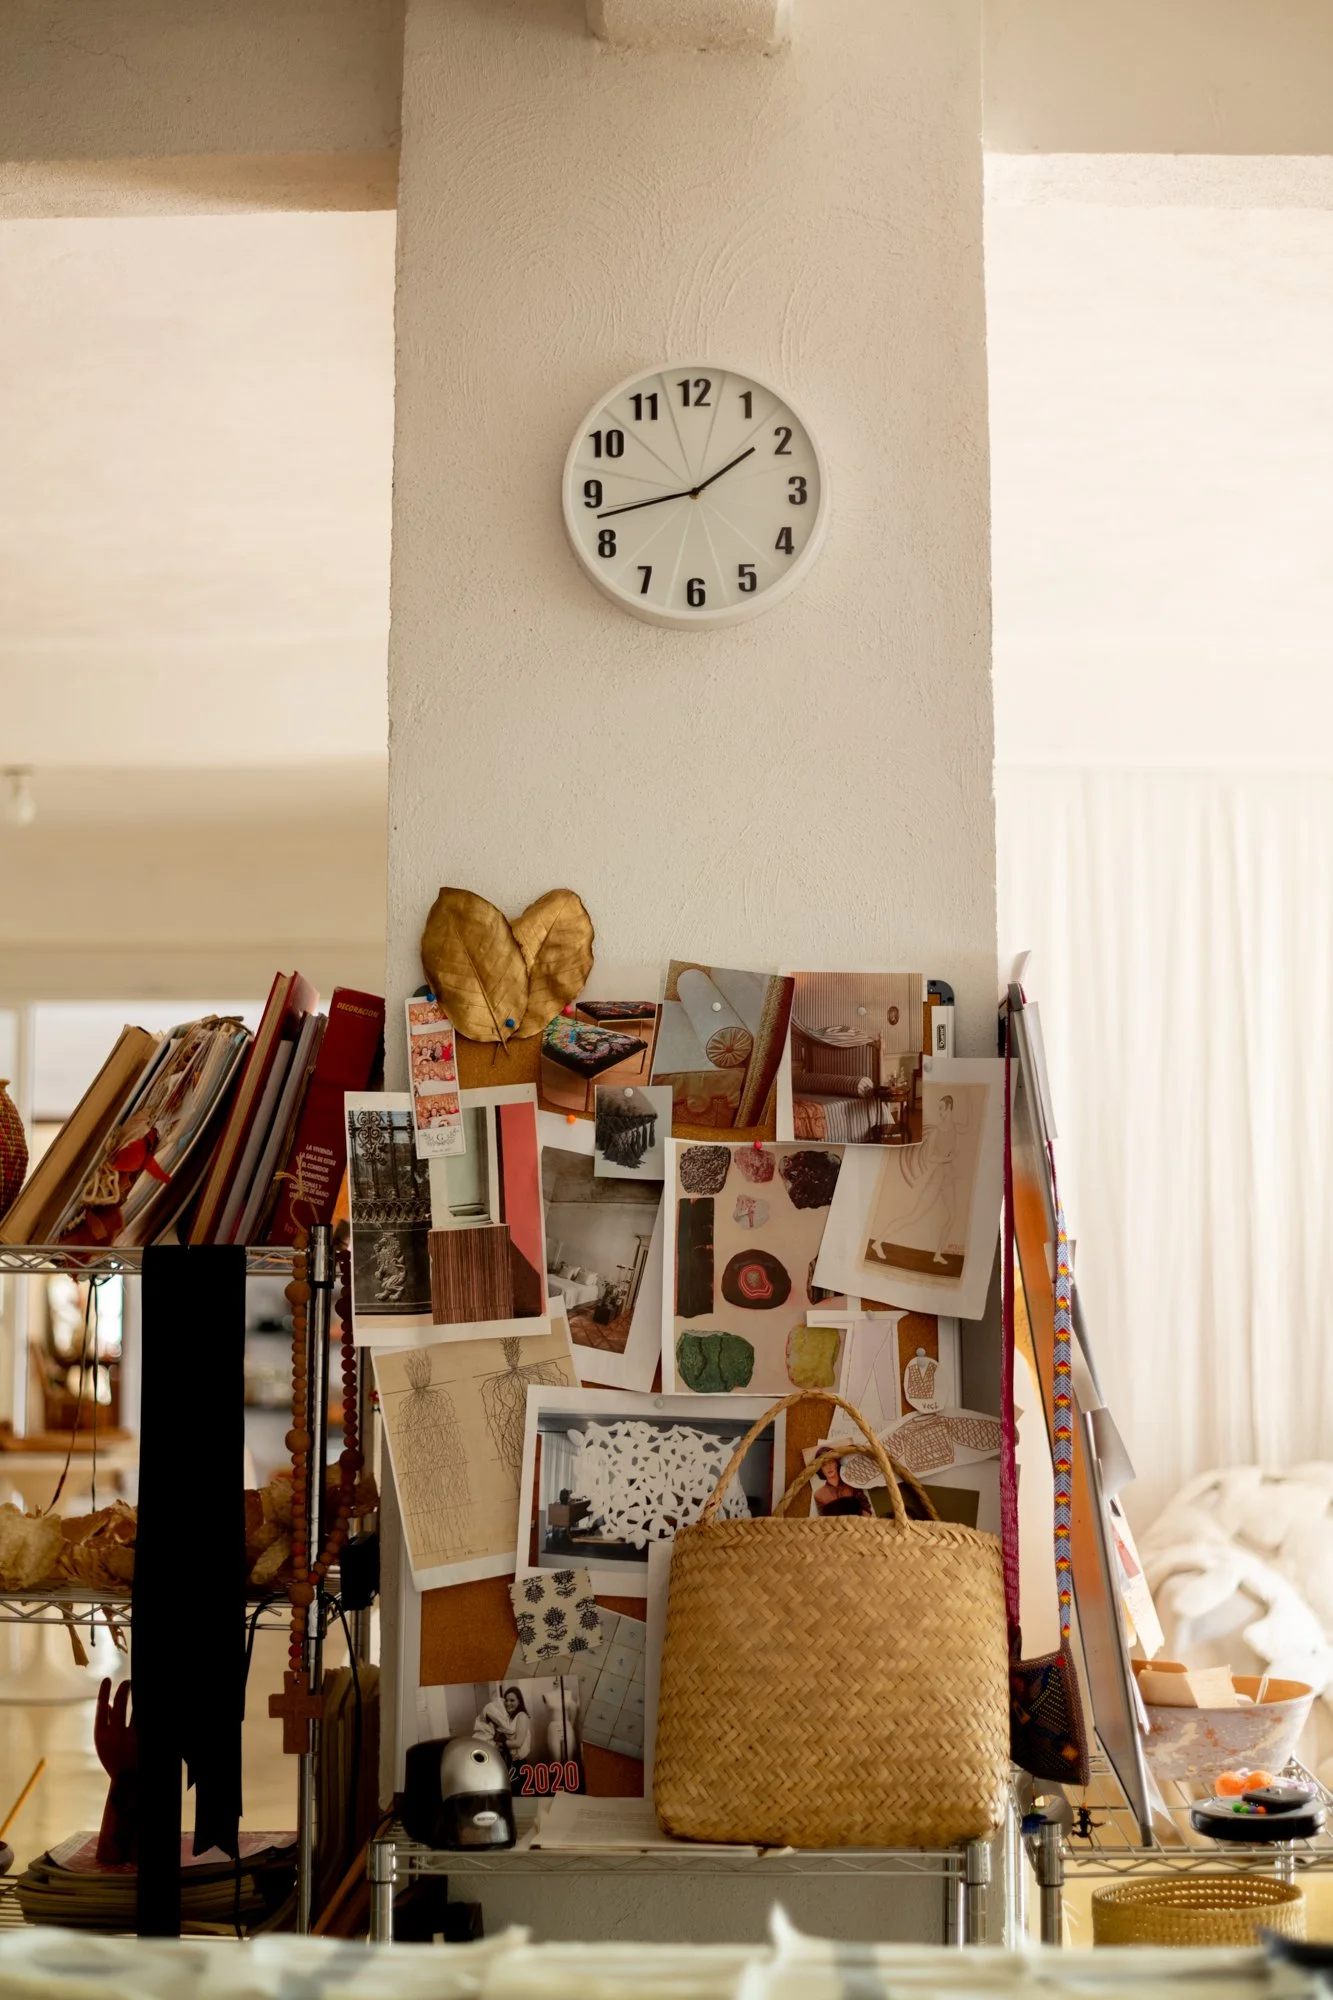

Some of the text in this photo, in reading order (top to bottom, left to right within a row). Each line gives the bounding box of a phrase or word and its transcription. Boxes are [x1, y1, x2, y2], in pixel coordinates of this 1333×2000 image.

[629, 393, 658, 421] 11
[677, 378, 712, 407] 12
[739, 391, 752, 419] 1
[589, 429, 624, 458] 10
[774, 427, 792, 455] 2
[583, 479, 603, 508] 9
[788, 476, 808, 505] 3
[597, 529, 617, 558] 8
[775, 527, 795, 555] 4
[637, 565, 653, 594] 7
[686, 578, 706, 607] 6
[738, 564, 757, 592] 5
[337, 1001, 379, 1019] DECORACION
[519, 1761, 580, 1796] 2020
